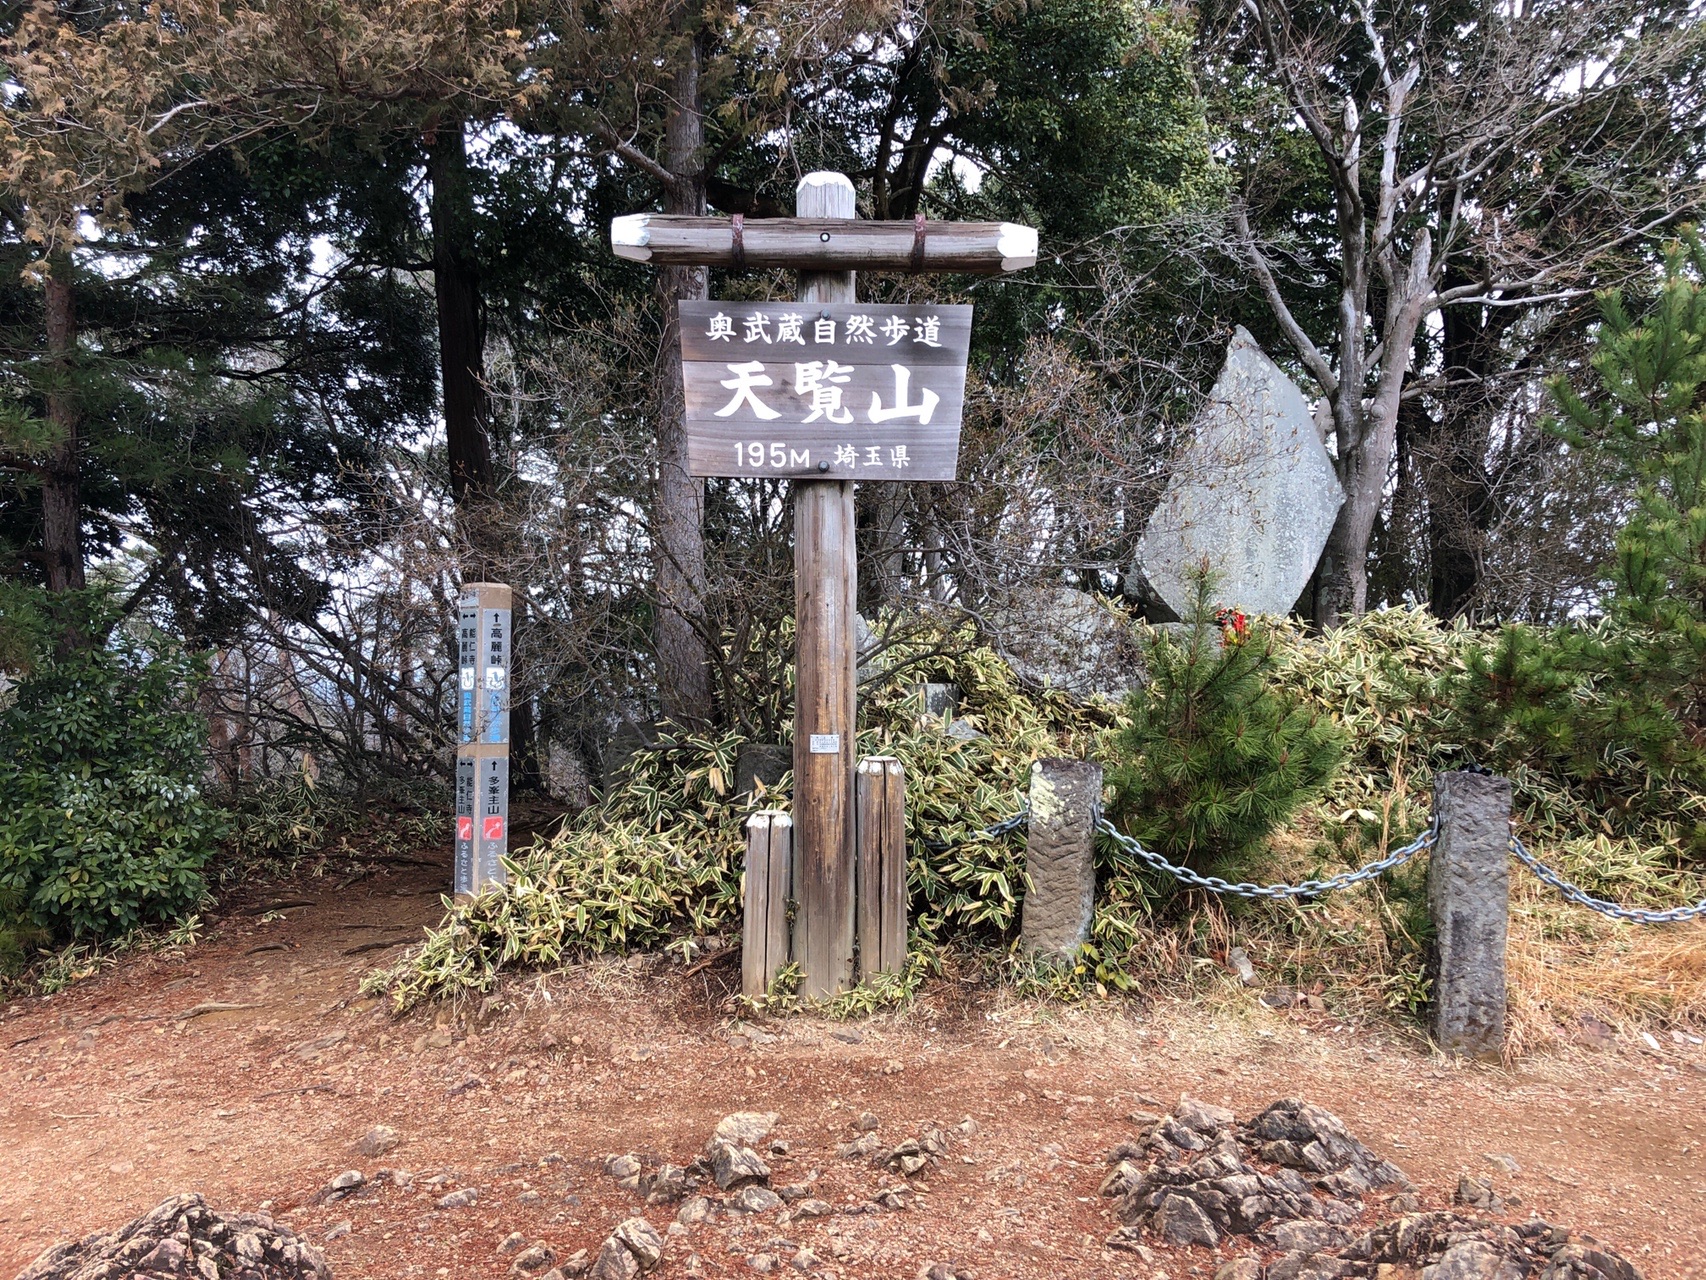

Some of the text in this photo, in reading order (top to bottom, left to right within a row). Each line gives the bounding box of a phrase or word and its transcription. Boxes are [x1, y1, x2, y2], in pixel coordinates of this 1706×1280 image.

[705, 311, 942, 348] 奥武蔵自然歩道
[713, 359, 940, 426] 天覧山
[734, 441, 911, 469] 195M 埼玉県
[490, 628, 503, 666] 高麗峠
